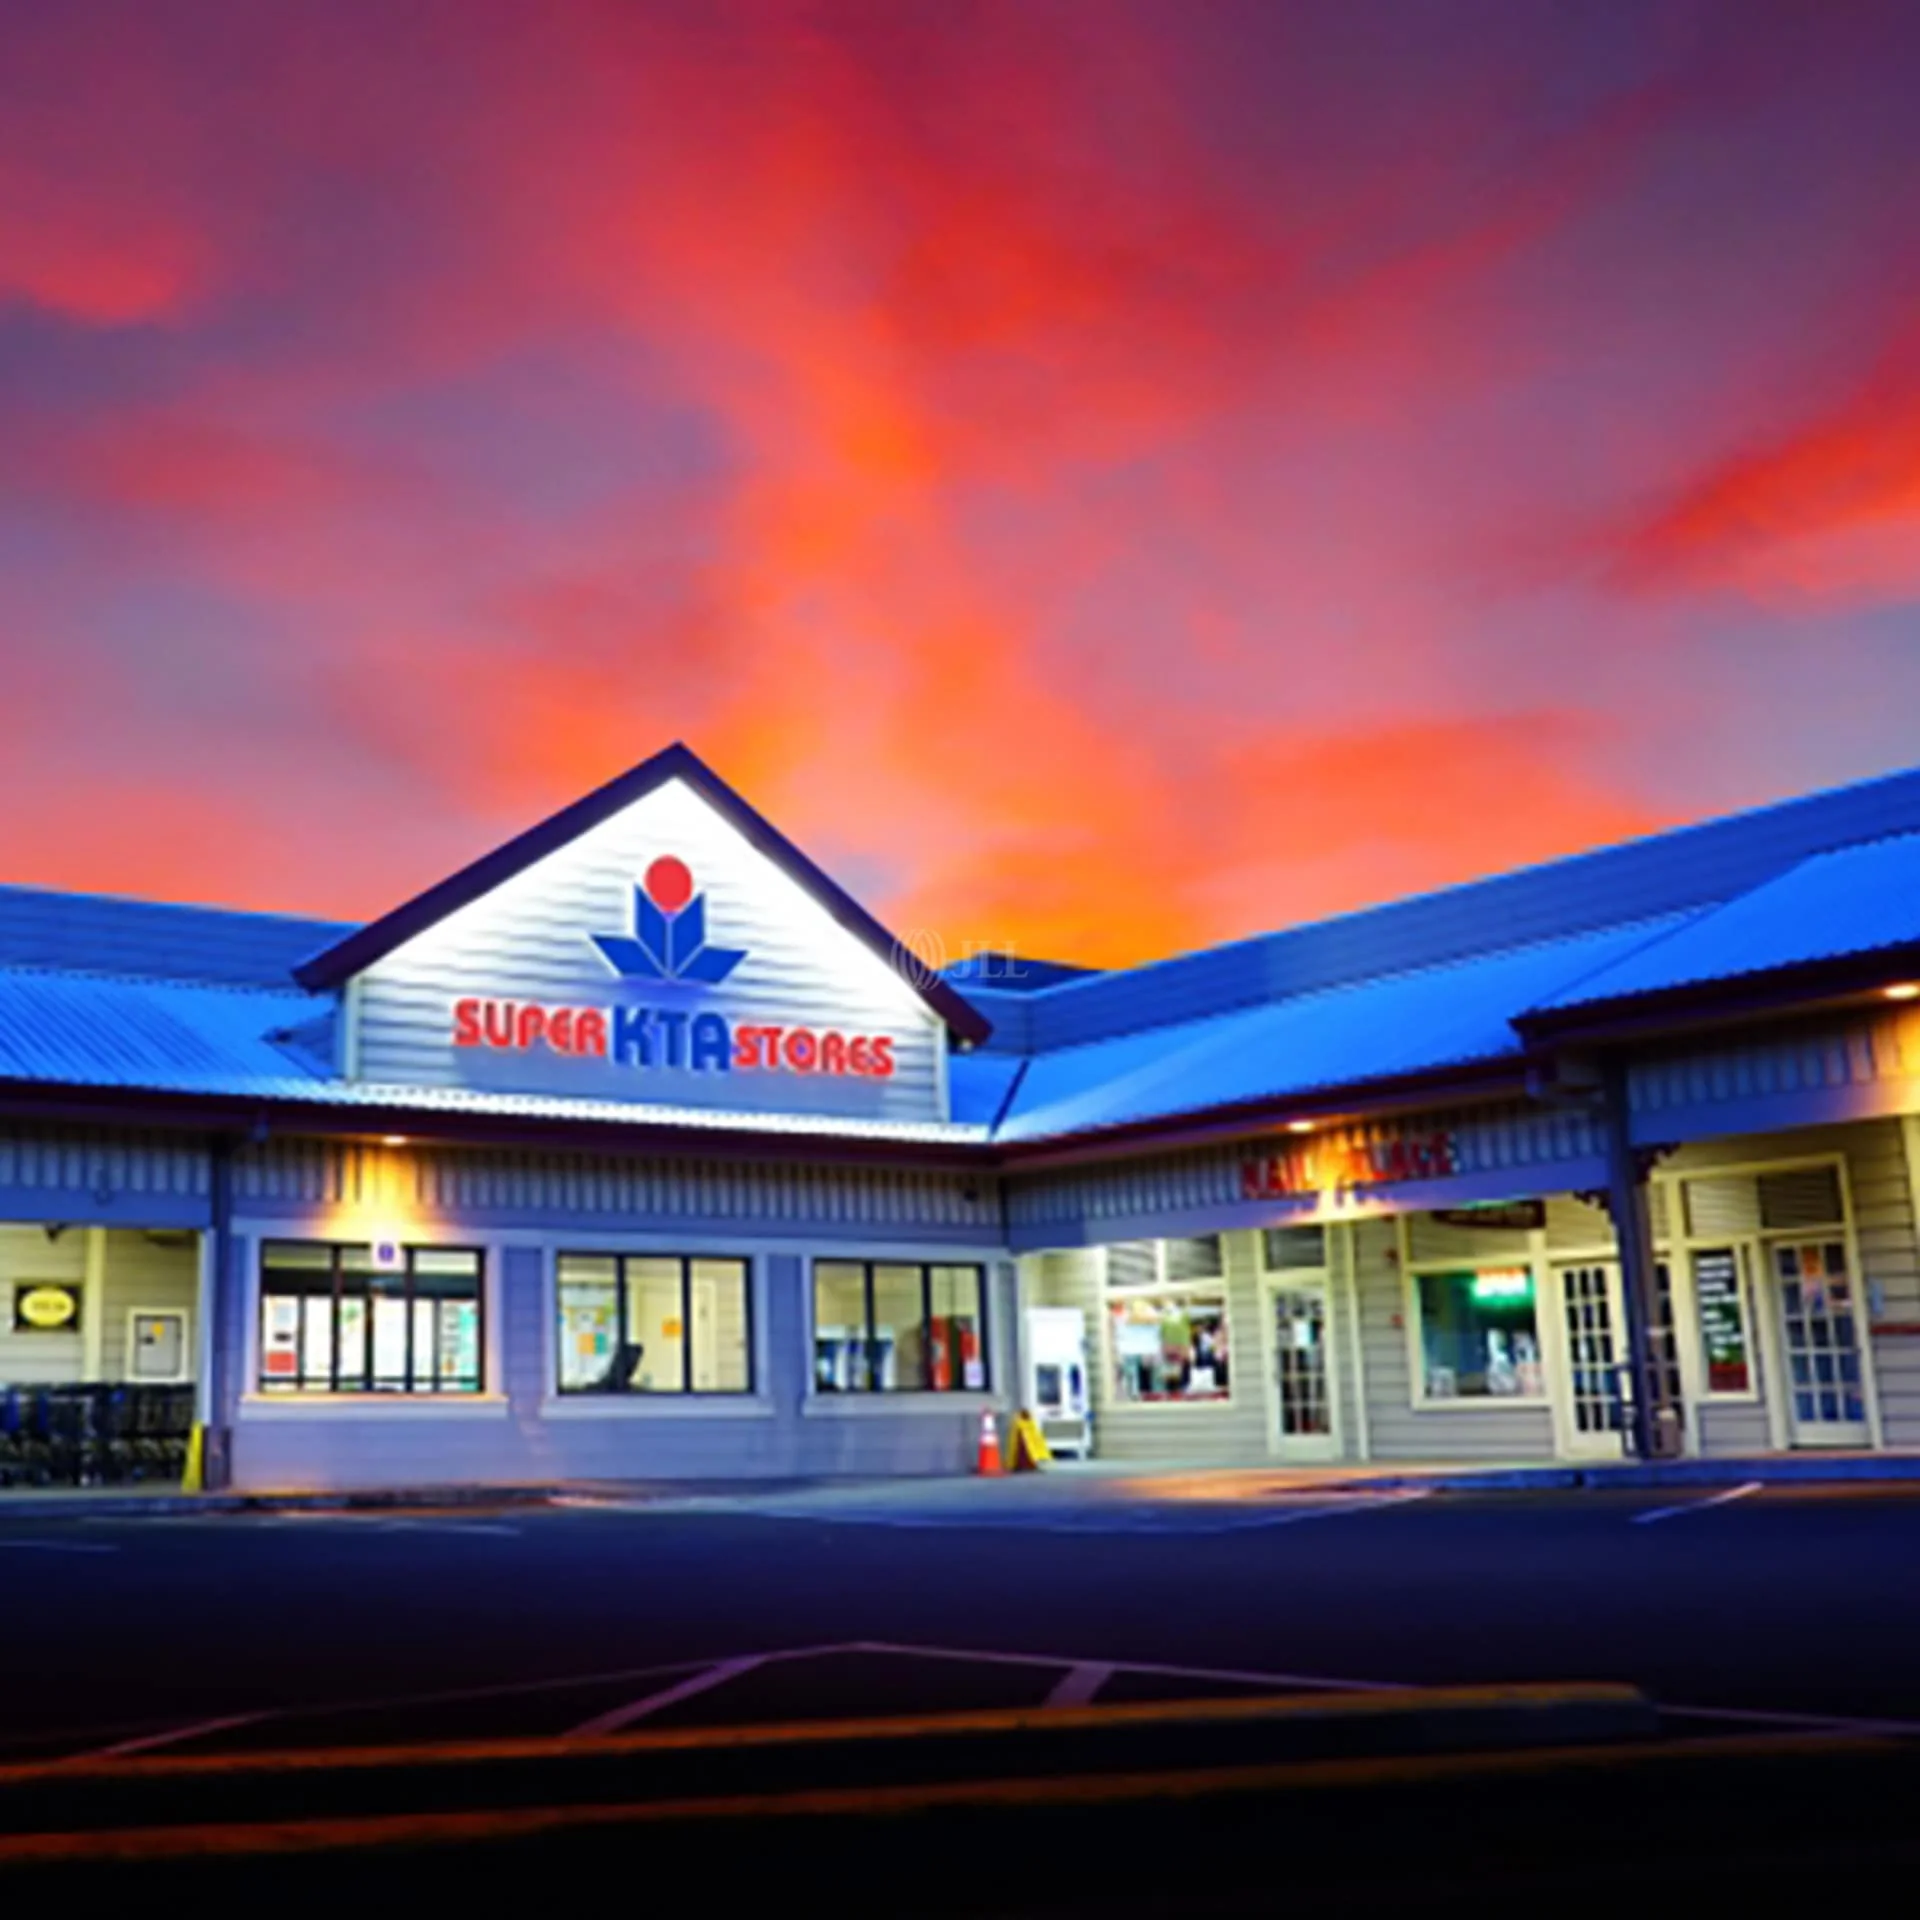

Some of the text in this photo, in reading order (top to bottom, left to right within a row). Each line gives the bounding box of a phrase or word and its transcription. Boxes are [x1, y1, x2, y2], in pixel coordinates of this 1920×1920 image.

[452, 999, 896, 1077] SUPER KTA STORES
